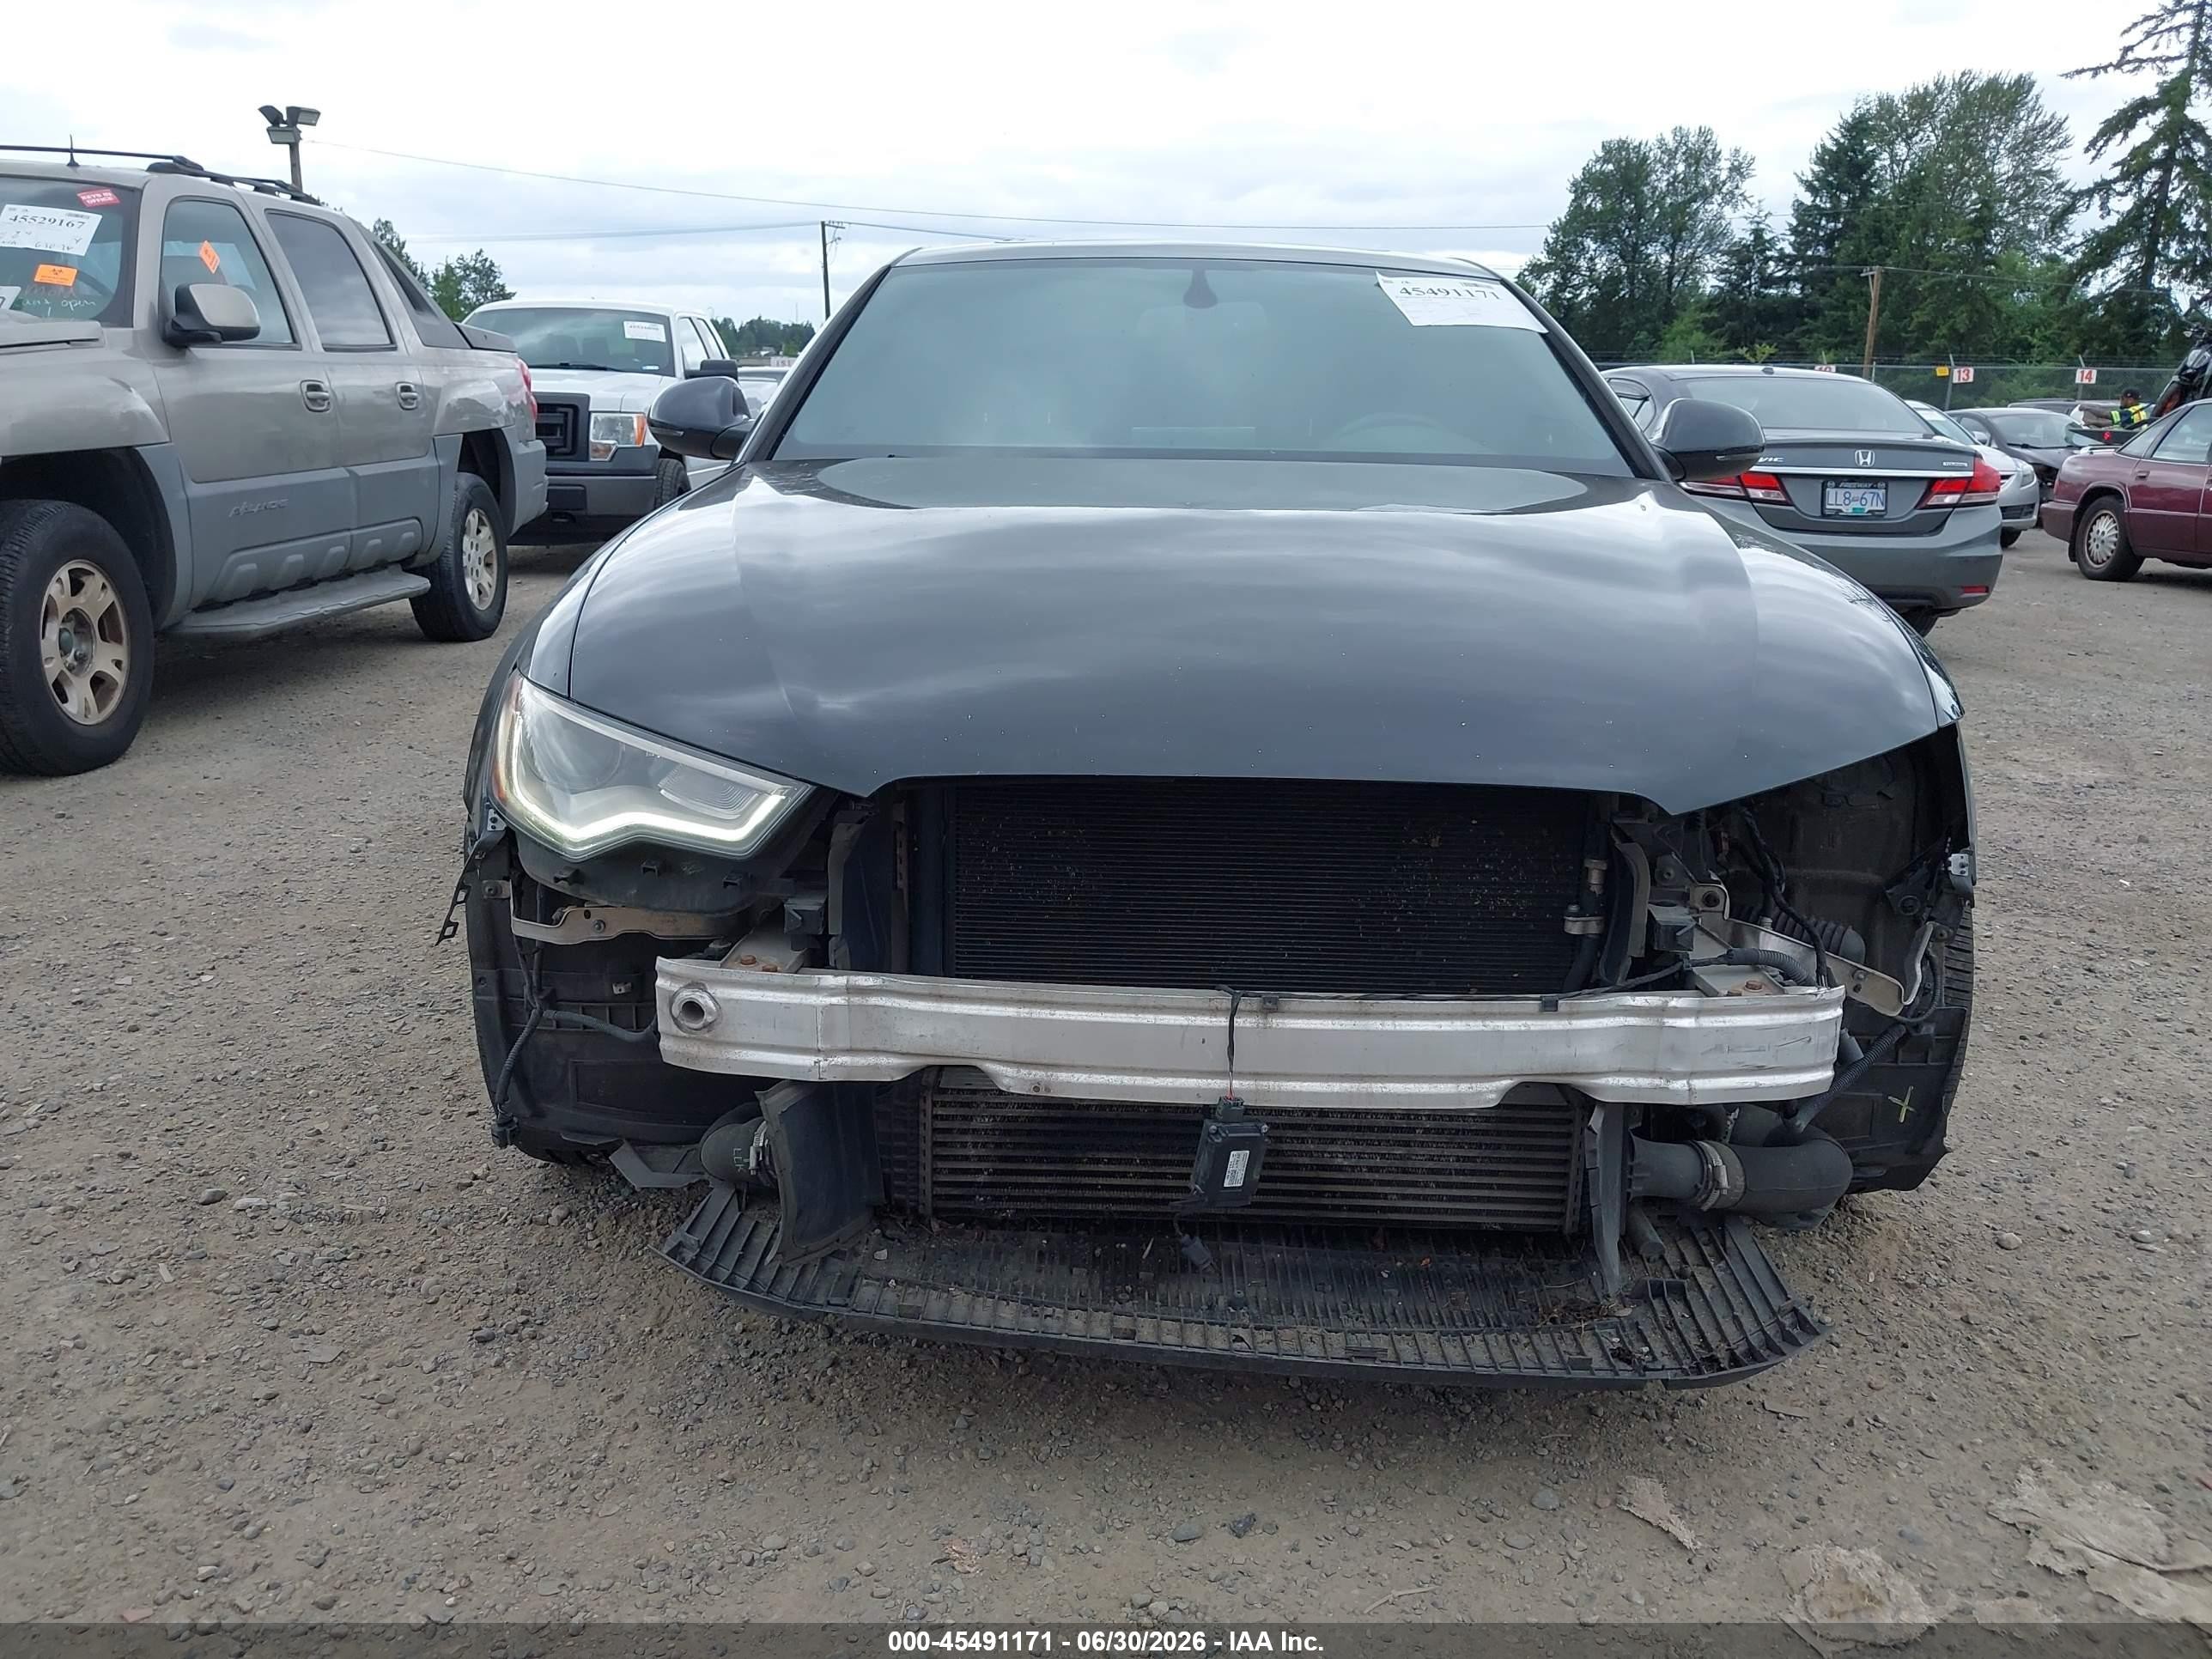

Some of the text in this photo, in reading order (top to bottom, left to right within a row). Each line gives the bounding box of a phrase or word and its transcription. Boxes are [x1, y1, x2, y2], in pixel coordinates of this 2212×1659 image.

[9, 213, 86, 228] 45529167
[1400, 287, 1500, 300] 45491171
[1956, 368, 1970, 381] 13
[2079, 369, 2093, 382] 14
